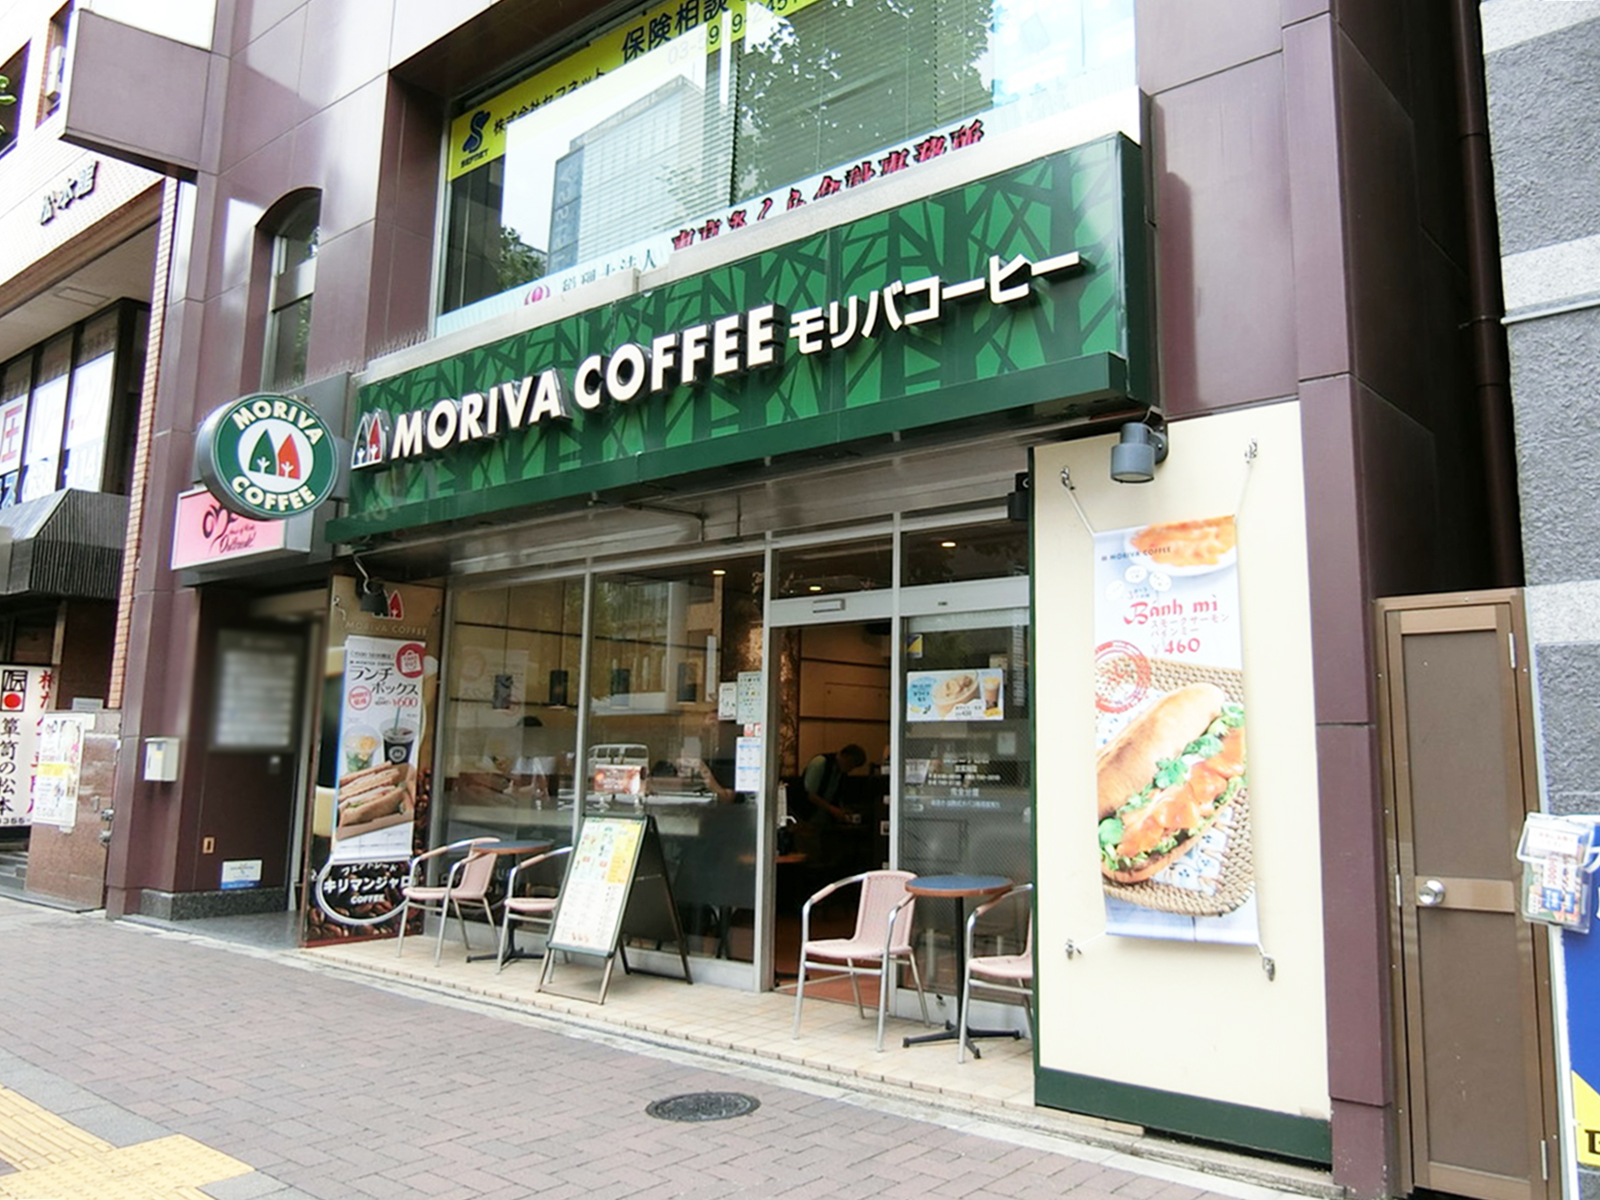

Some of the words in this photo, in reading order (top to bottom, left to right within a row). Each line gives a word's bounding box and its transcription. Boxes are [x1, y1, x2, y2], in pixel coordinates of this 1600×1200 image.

[390, 368, 563, 460] MORIVA
[574, 304, 777, 410] COFFEE
[789, 251, 1080, 355] モリバコーヒー
[231, 400, 325, 446] MORIVA
[231, 475, 317, 511] COFFEE
[350, 666, 394, 681] ランチ
[371, 681, 419, 696] ボックス
[323, 875, 411, 895] キリマンジャロ
